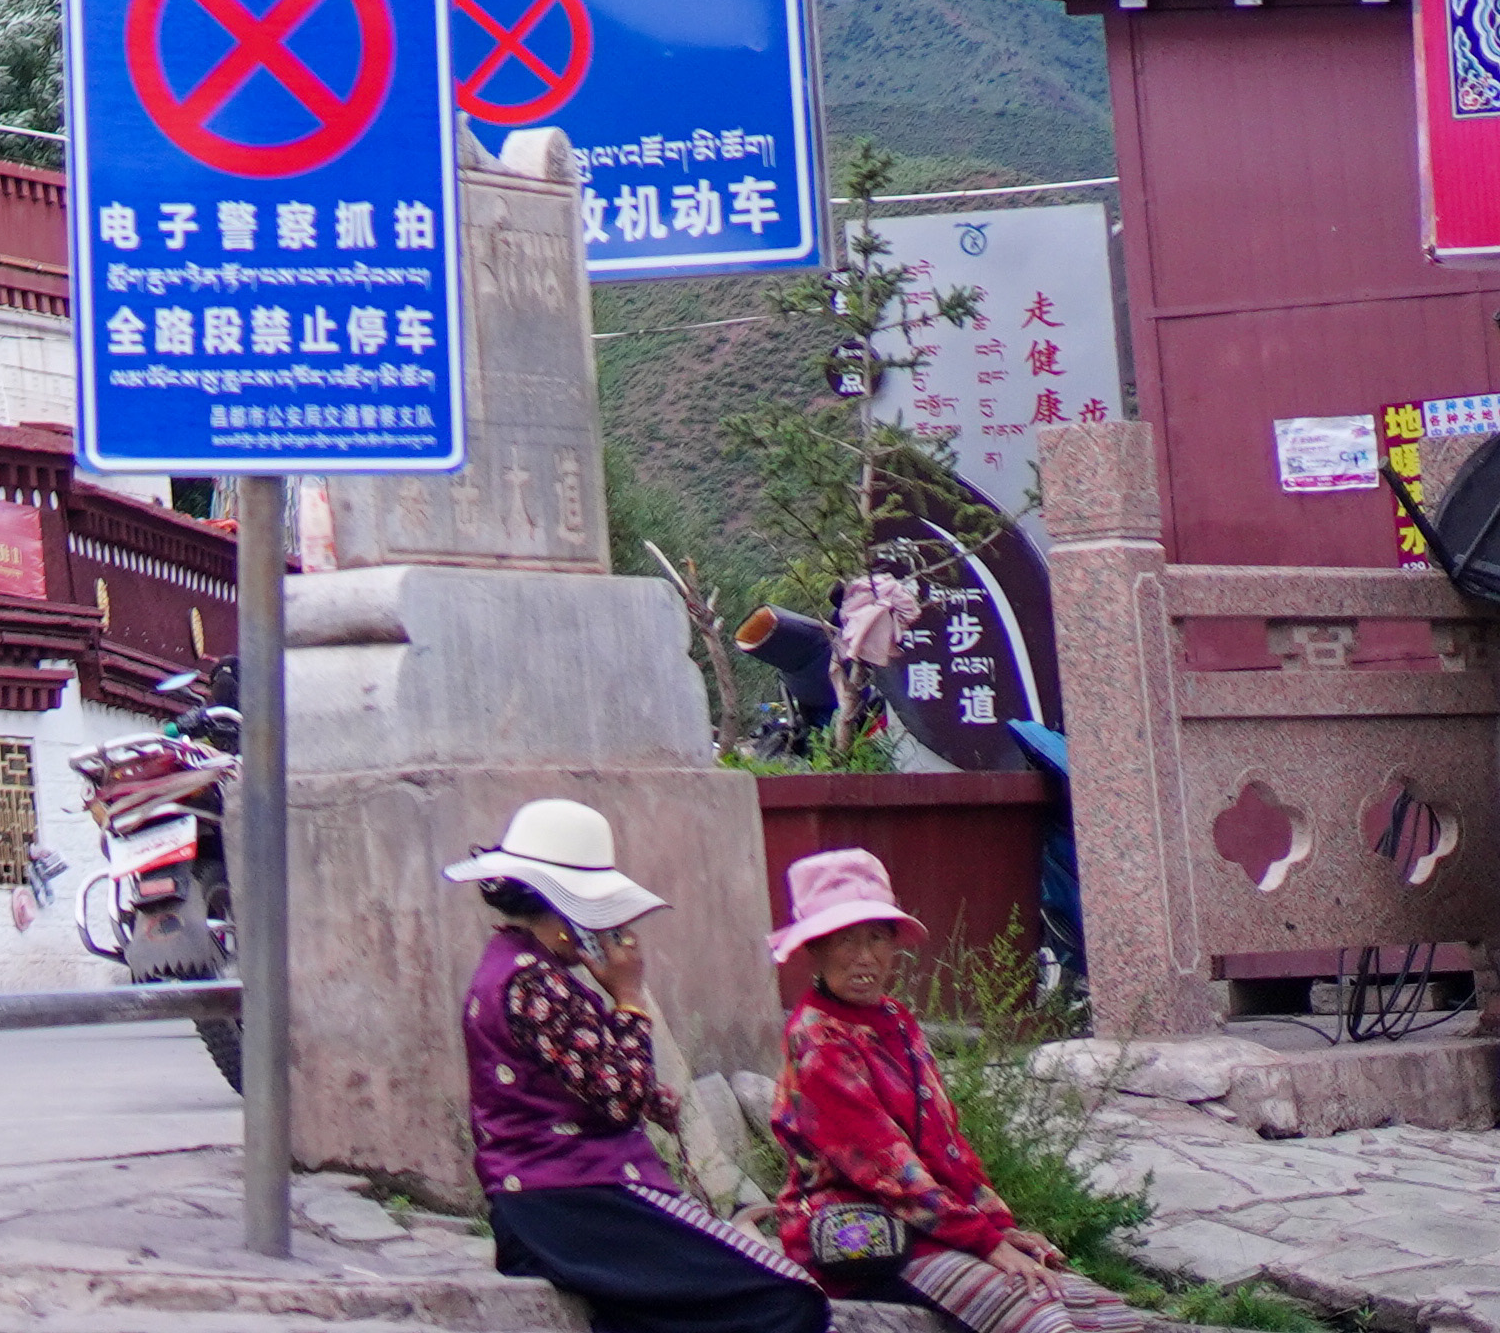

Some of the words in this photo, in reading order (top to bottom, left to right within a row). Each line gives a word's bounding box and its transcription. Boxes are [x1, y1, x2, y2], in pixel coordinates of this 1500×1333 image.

[99, 199, 435, 251] 电子警察抓拍
[106, 305, 437, 355] 全路段禁止停车
[1021, 290, 1072, 426] 走健康
[209, 405, 437, 428] 昌都市公安局交通警察支队
[907, 661, 944, 700] 康
